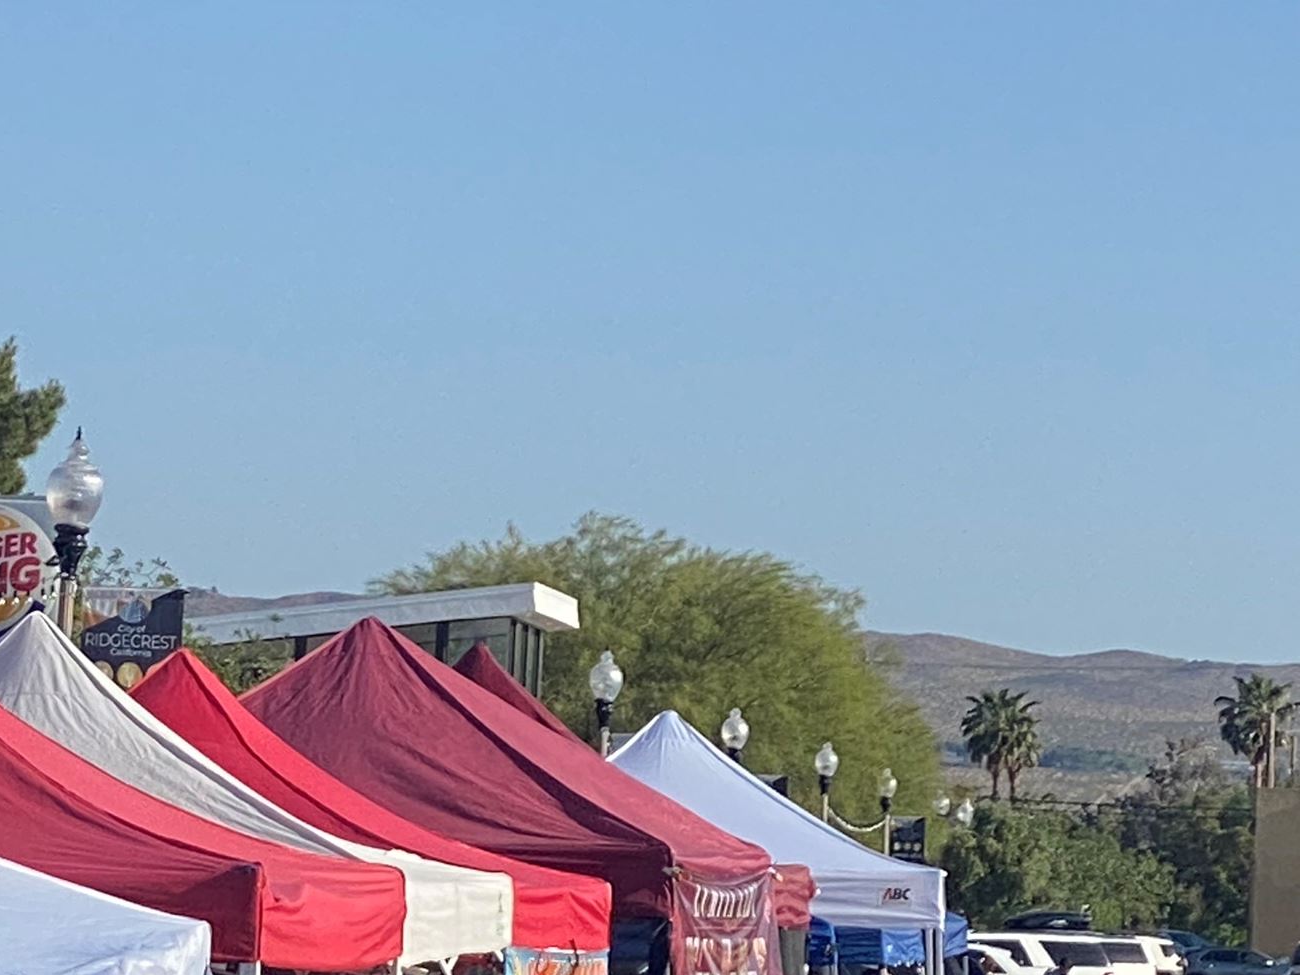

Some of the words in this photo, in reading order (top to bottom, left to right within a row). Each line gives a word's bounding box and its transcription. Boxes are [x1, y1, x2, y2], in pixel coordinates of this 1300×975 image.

[117, 624, 135, 635] City
[135, 624, 147, 633] of
[84, 632, 178, 650] RIDGECREST
[882, 887, 912, 901] ABC
